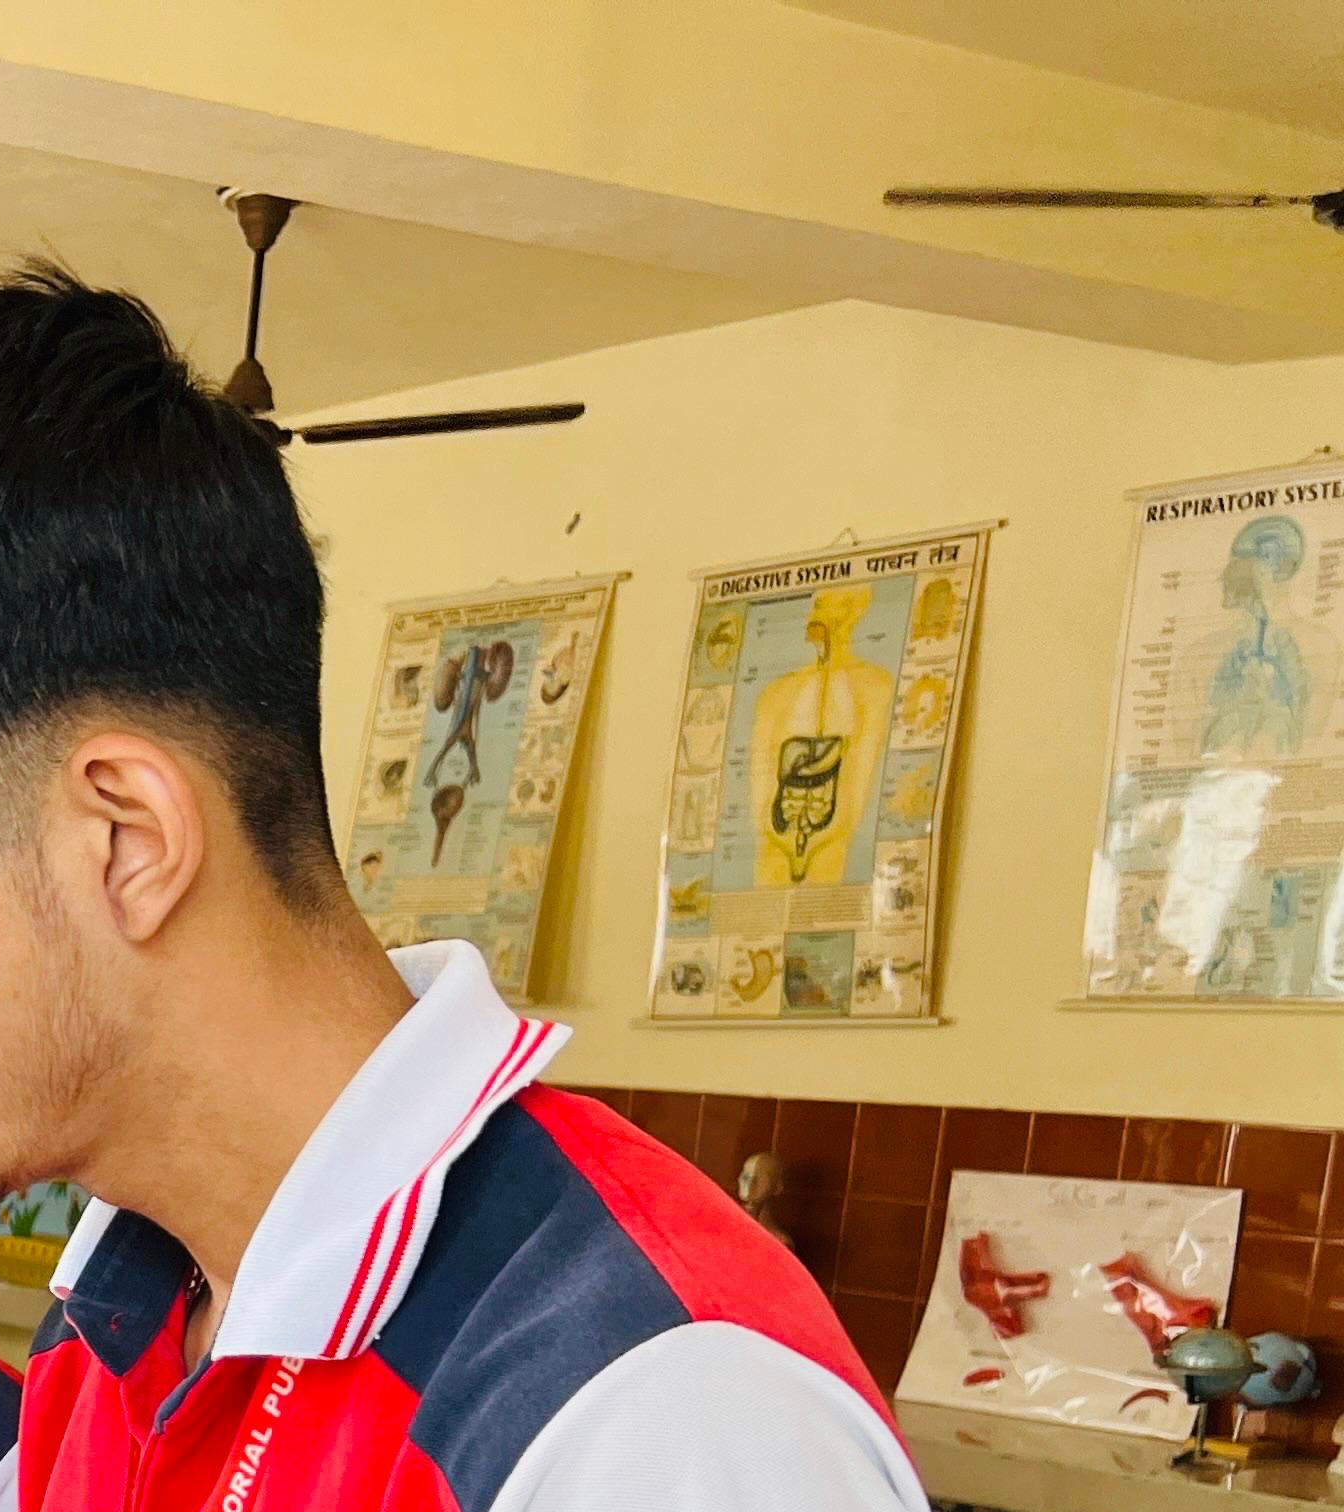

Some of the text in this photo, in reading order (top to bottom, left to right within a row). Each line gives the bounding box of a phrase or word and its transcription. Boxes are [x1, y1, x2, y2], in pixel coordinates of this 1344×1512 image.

[1146, 480, 1344, 522] RESPIRATORY SYSTE
[866, 542, 961, 573] पाचन तंत्र
[720, 561, 851, 597] DIGESTIVE SYSTEM
